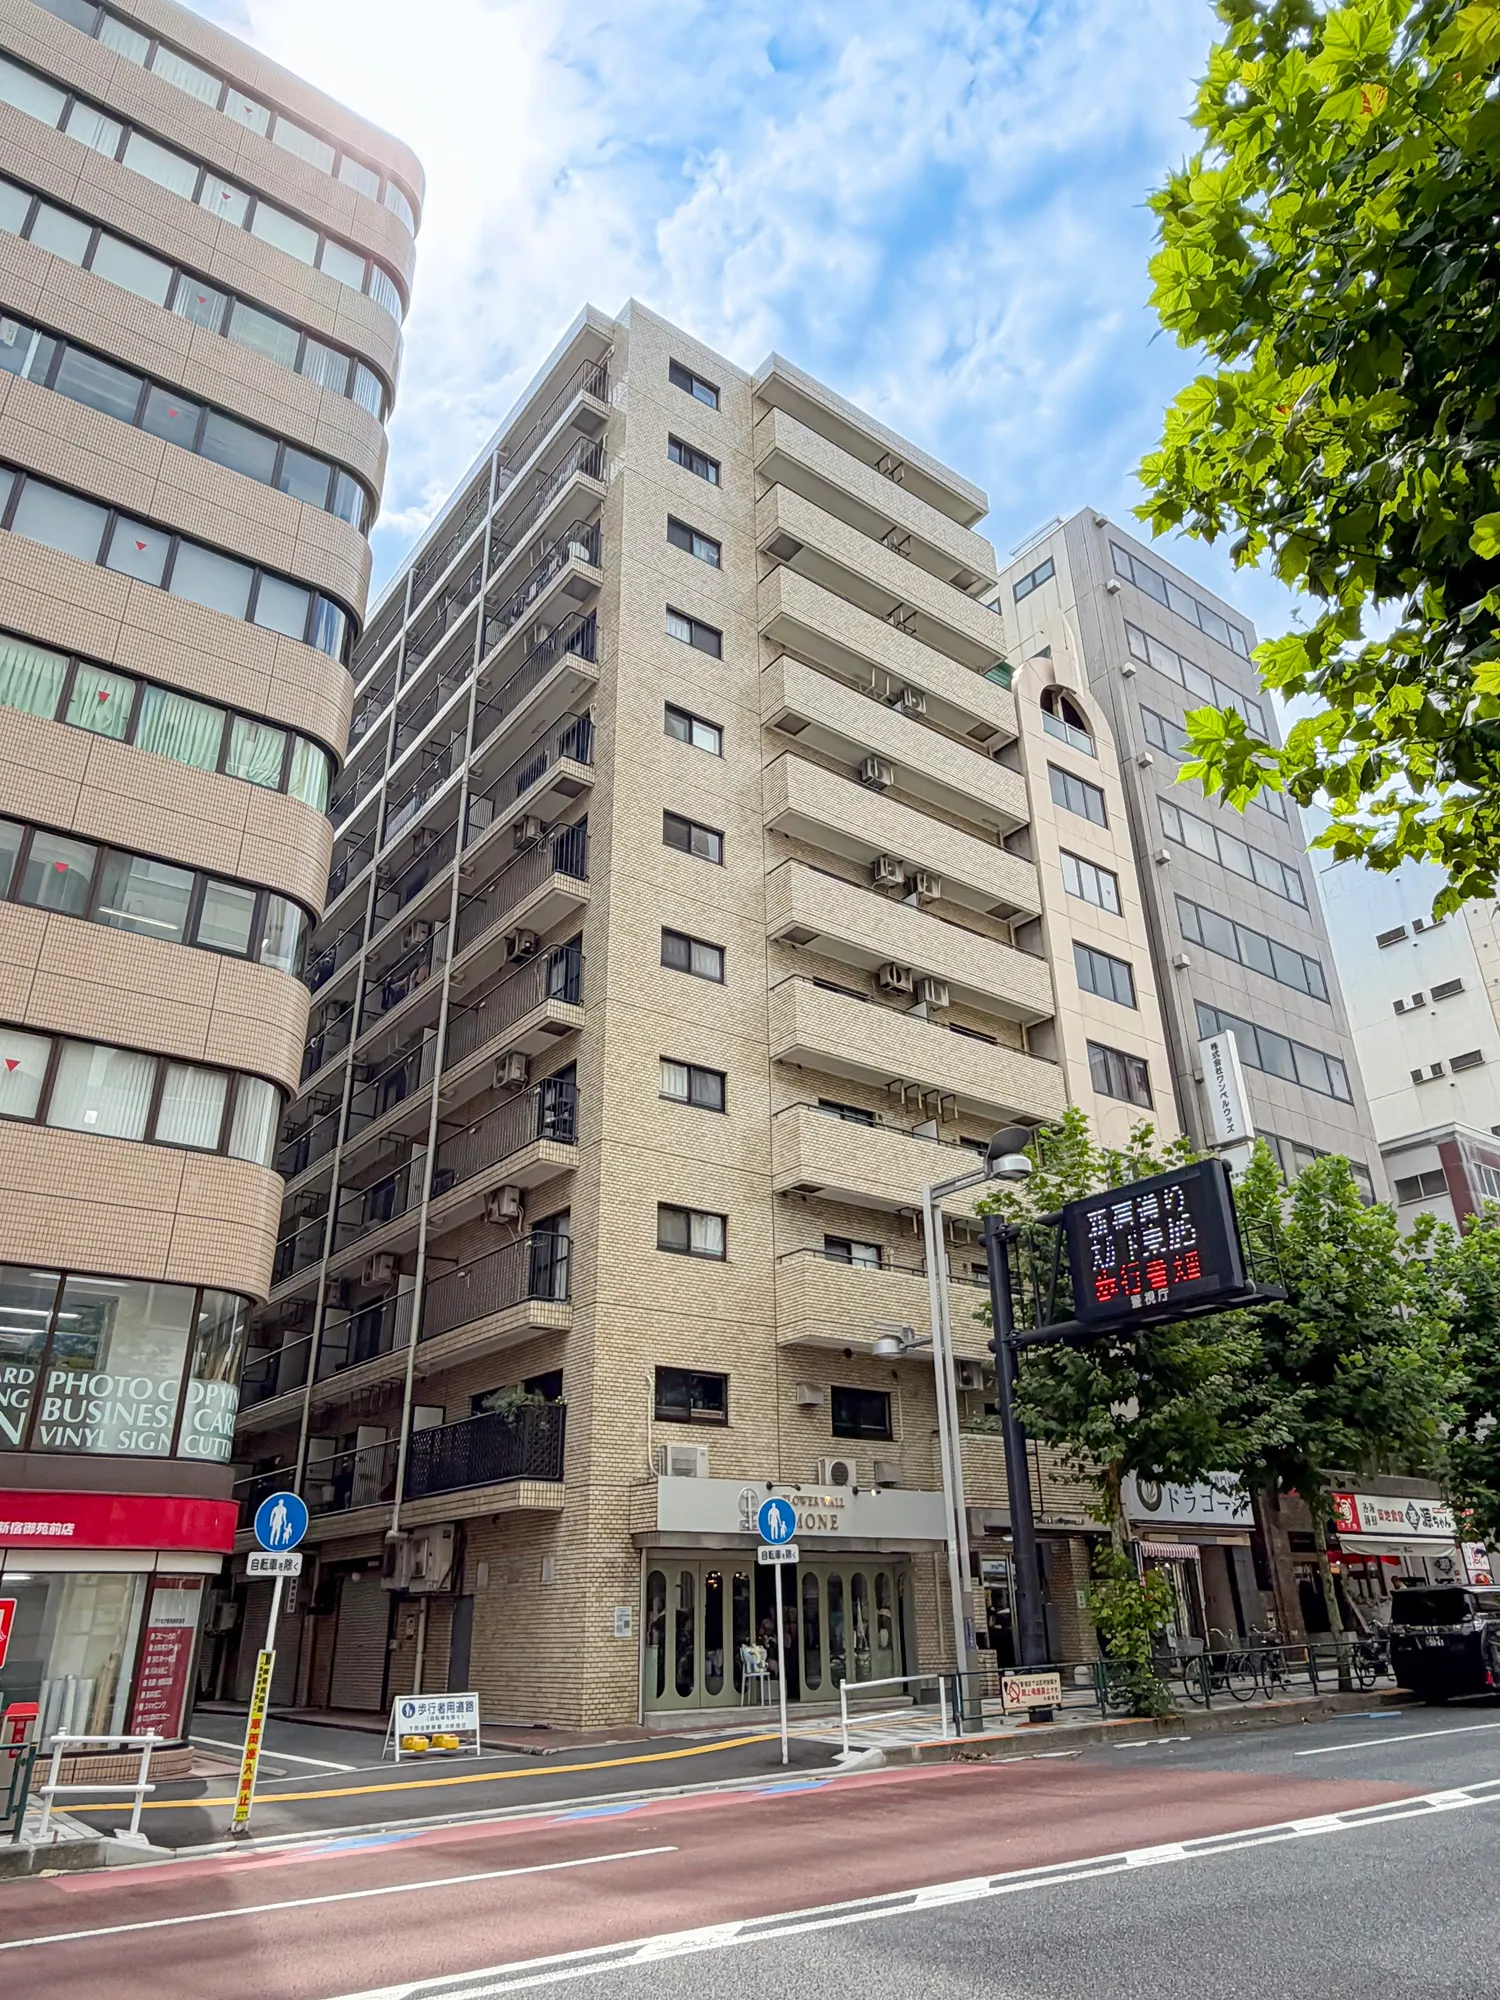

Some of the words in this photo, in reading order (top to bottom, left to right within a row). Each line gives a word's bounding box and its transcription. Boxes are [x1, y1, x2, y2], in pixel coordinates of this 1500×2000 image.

[1130, 1288, 1169, 1309] 警視庁
[0, 1367, 35, 1385] RD
[41, 1397, 174, 1429] BUSINES
[40, 1425, 107, 1448] VINYL
[251, 1558, 299, 1572] 自転車を除く
[418, 1700, 474, 1716] 歩行者用道路
